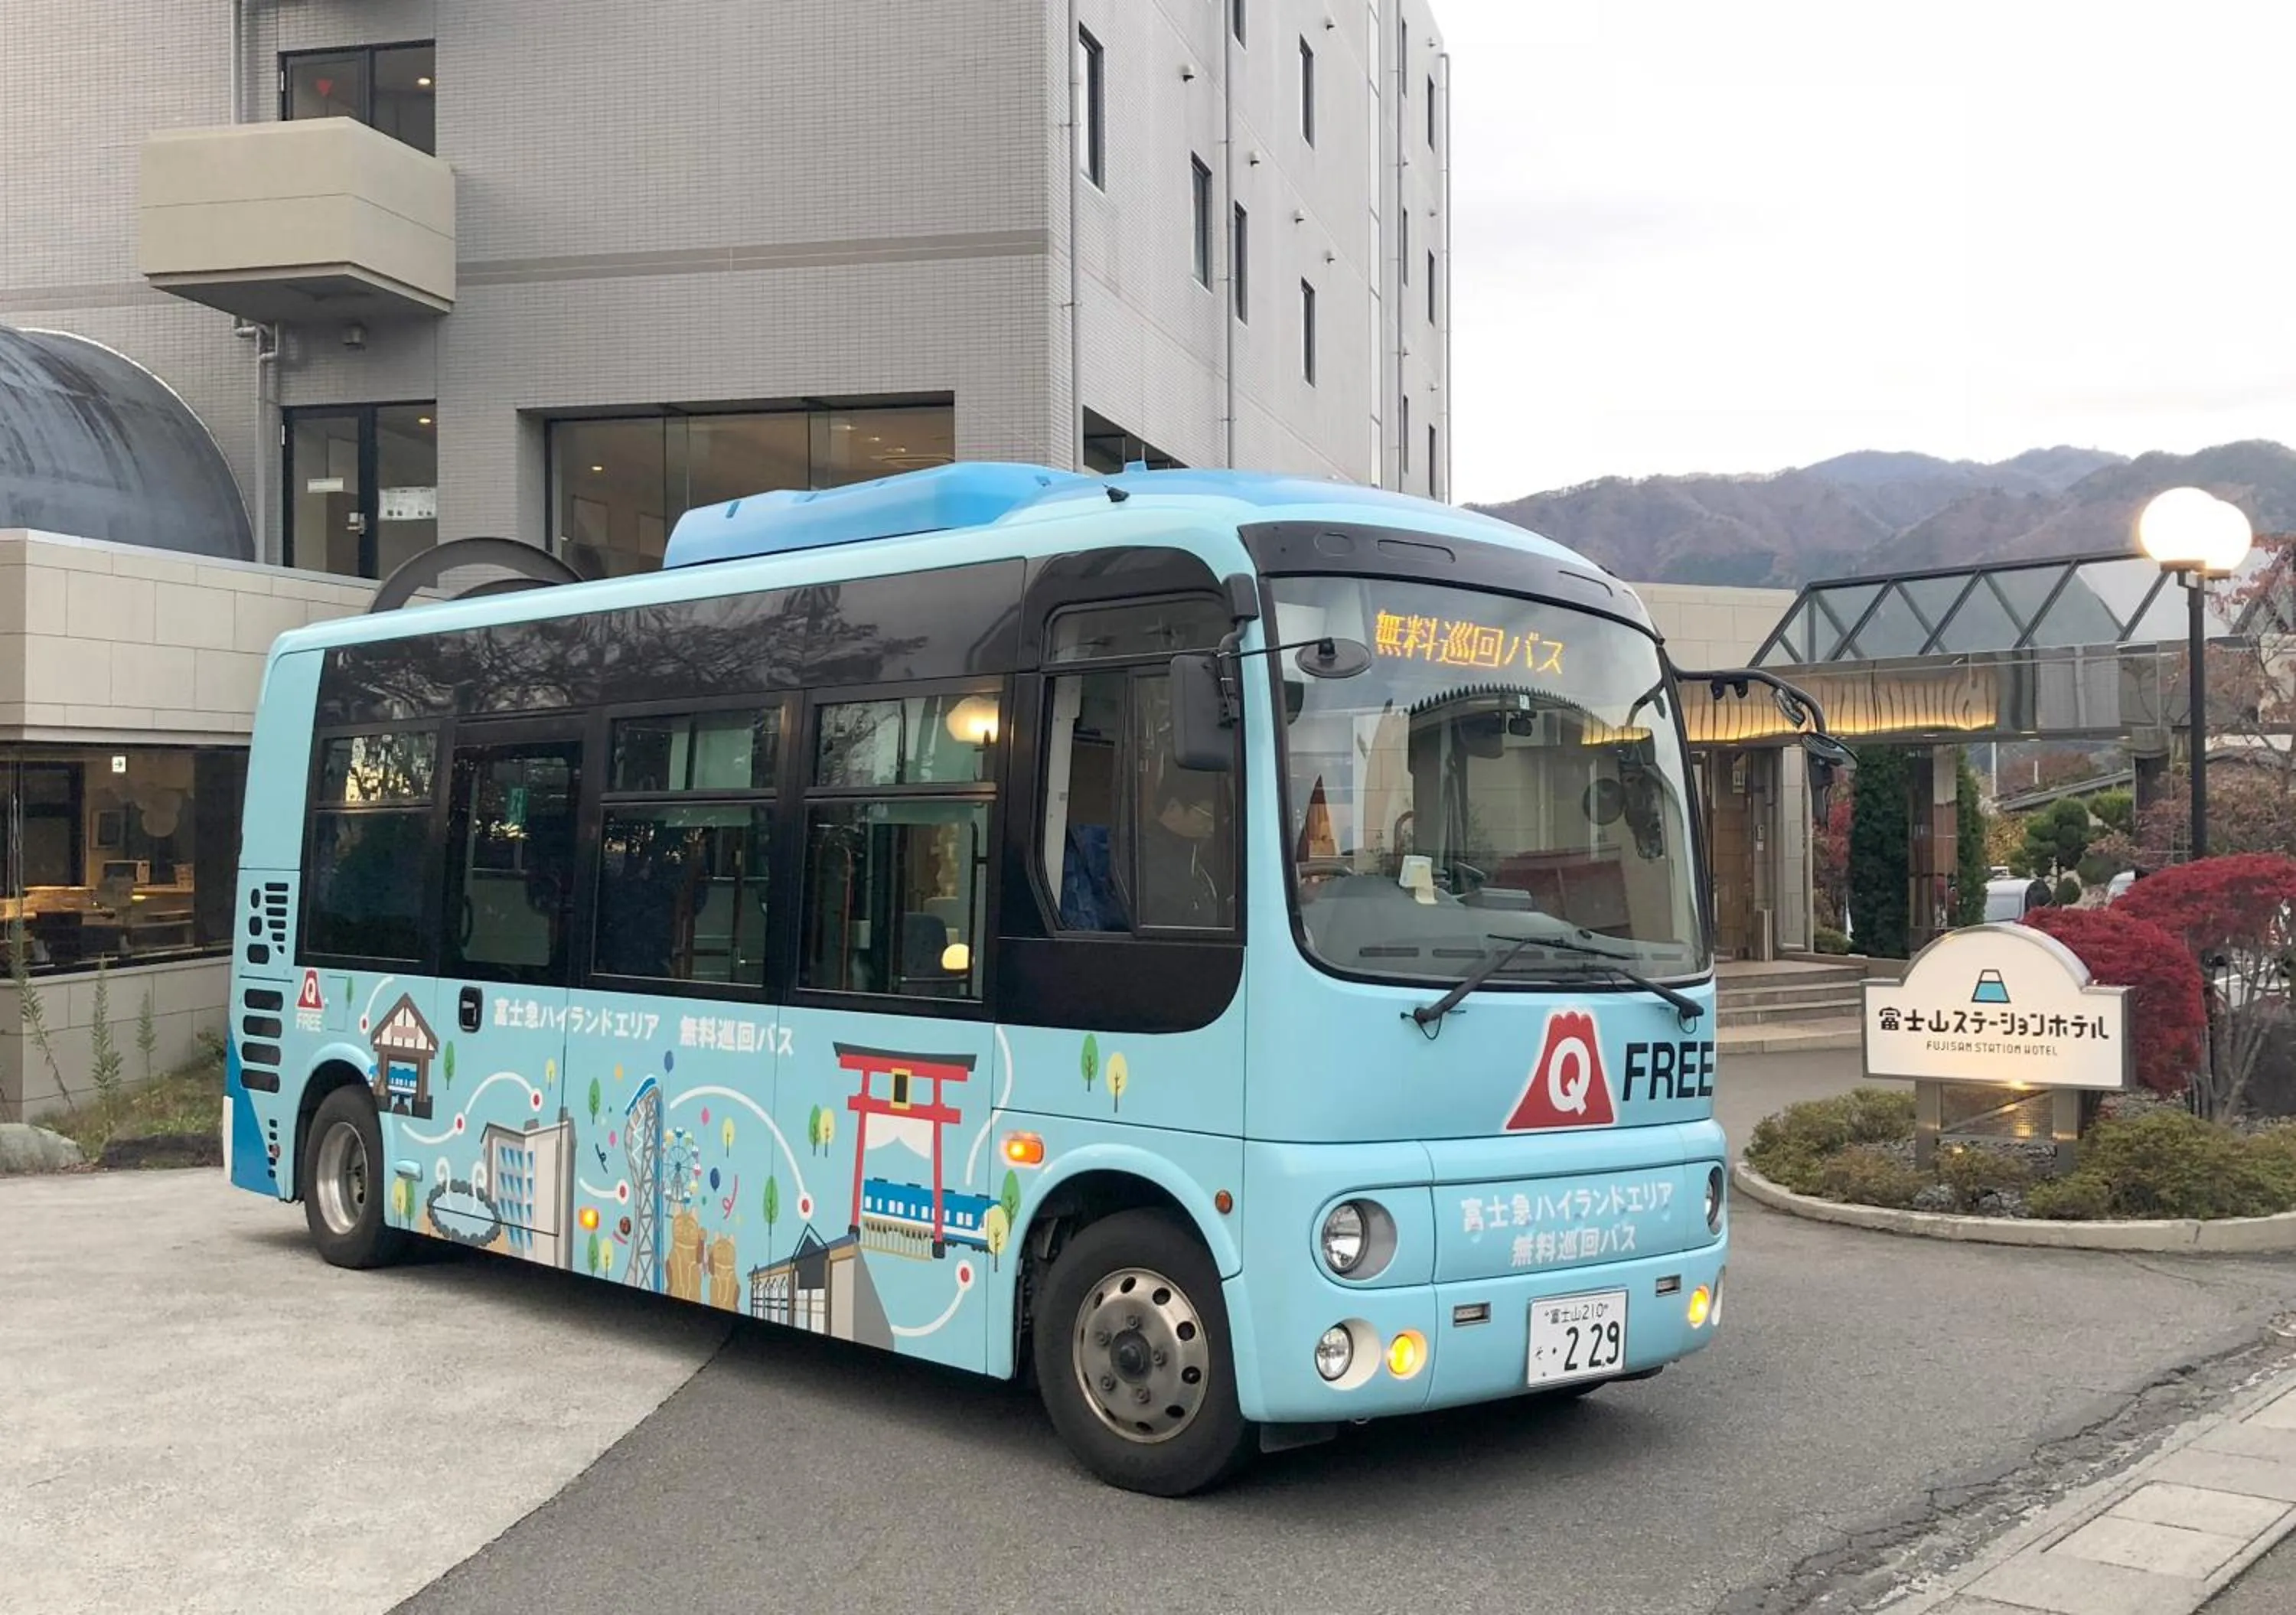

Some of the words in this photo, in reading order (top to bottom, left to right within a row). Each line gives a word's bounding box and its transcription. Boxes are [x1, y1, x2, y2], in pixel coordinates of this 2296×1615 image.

[1376, 608, 1564, 674] 無料巡回バス
[305, 977, 316, 1004] Q
[296, 1013, 321, 1032] FREE
[494, 997, 660, 1041] 富士急ハイランドエリア
[679, 1015, 794, 1057] 無料巡回バス
[1878, 1007, 2109, 1039] 富士山ステーションホテル
[1926, 1040, 1972, 1052] FUJISAN
[1975, 1042, 2021, 1055] STATION
[2024, 1044, 2058, 1056] HOTEL
[1548, 1036, 1591, 1115] Q
[1622, 1041, 1714, 1101] FREE
[1460, 1181, 1673, 1233] 富士急ハイランドエリア
[1511, 1224, 1636, 1268] 無料巡回バス
